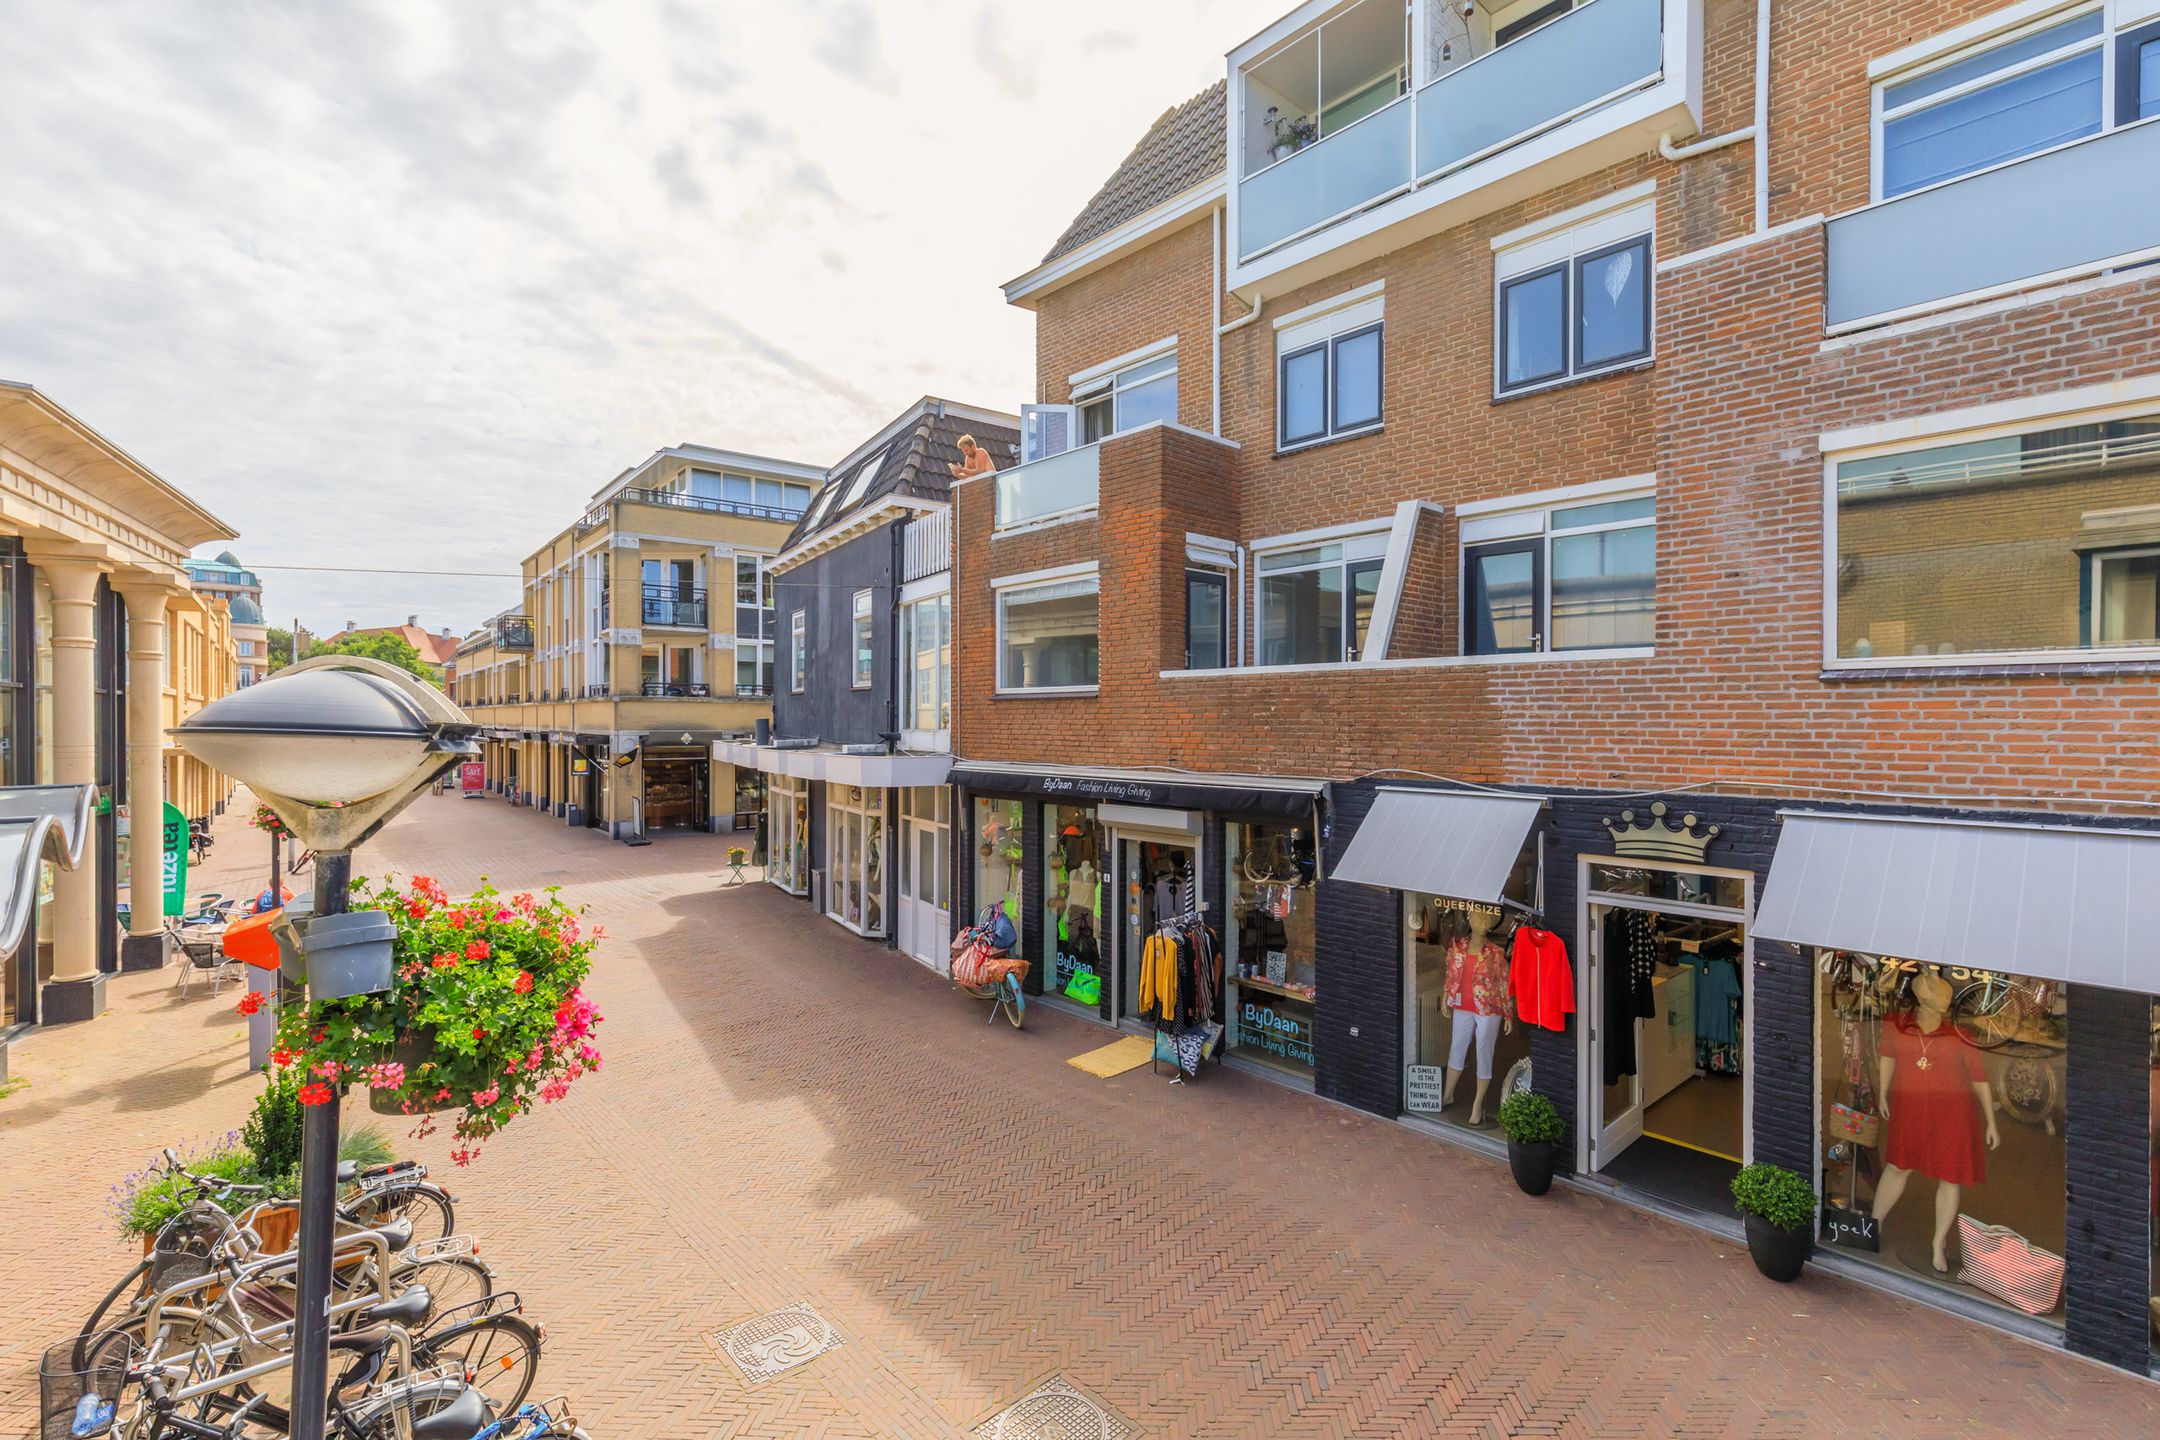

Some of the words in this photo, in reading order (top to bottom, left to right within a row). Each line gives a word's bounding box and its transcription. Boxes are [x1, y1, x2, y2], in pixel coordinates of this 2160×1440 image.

[1043, 778, 1072, 792] ByDaan
[1076, 780, 1103, 793] Fashion
[1103, 782, 1126, 798] Living
[1127, 783, 1152, 800] Giving
[1434, 897, 1502, 916] QUEENSIZE
[1057, 951, 1094, 975] ByDaan
[1245, 1003, 1299, 1034] ByDaan
[1261, 1034, 1287, 1058] Living
[1287, 1042, 1315, 1067] Giving
[1421, 1101, 1440, 1109] WEAR
